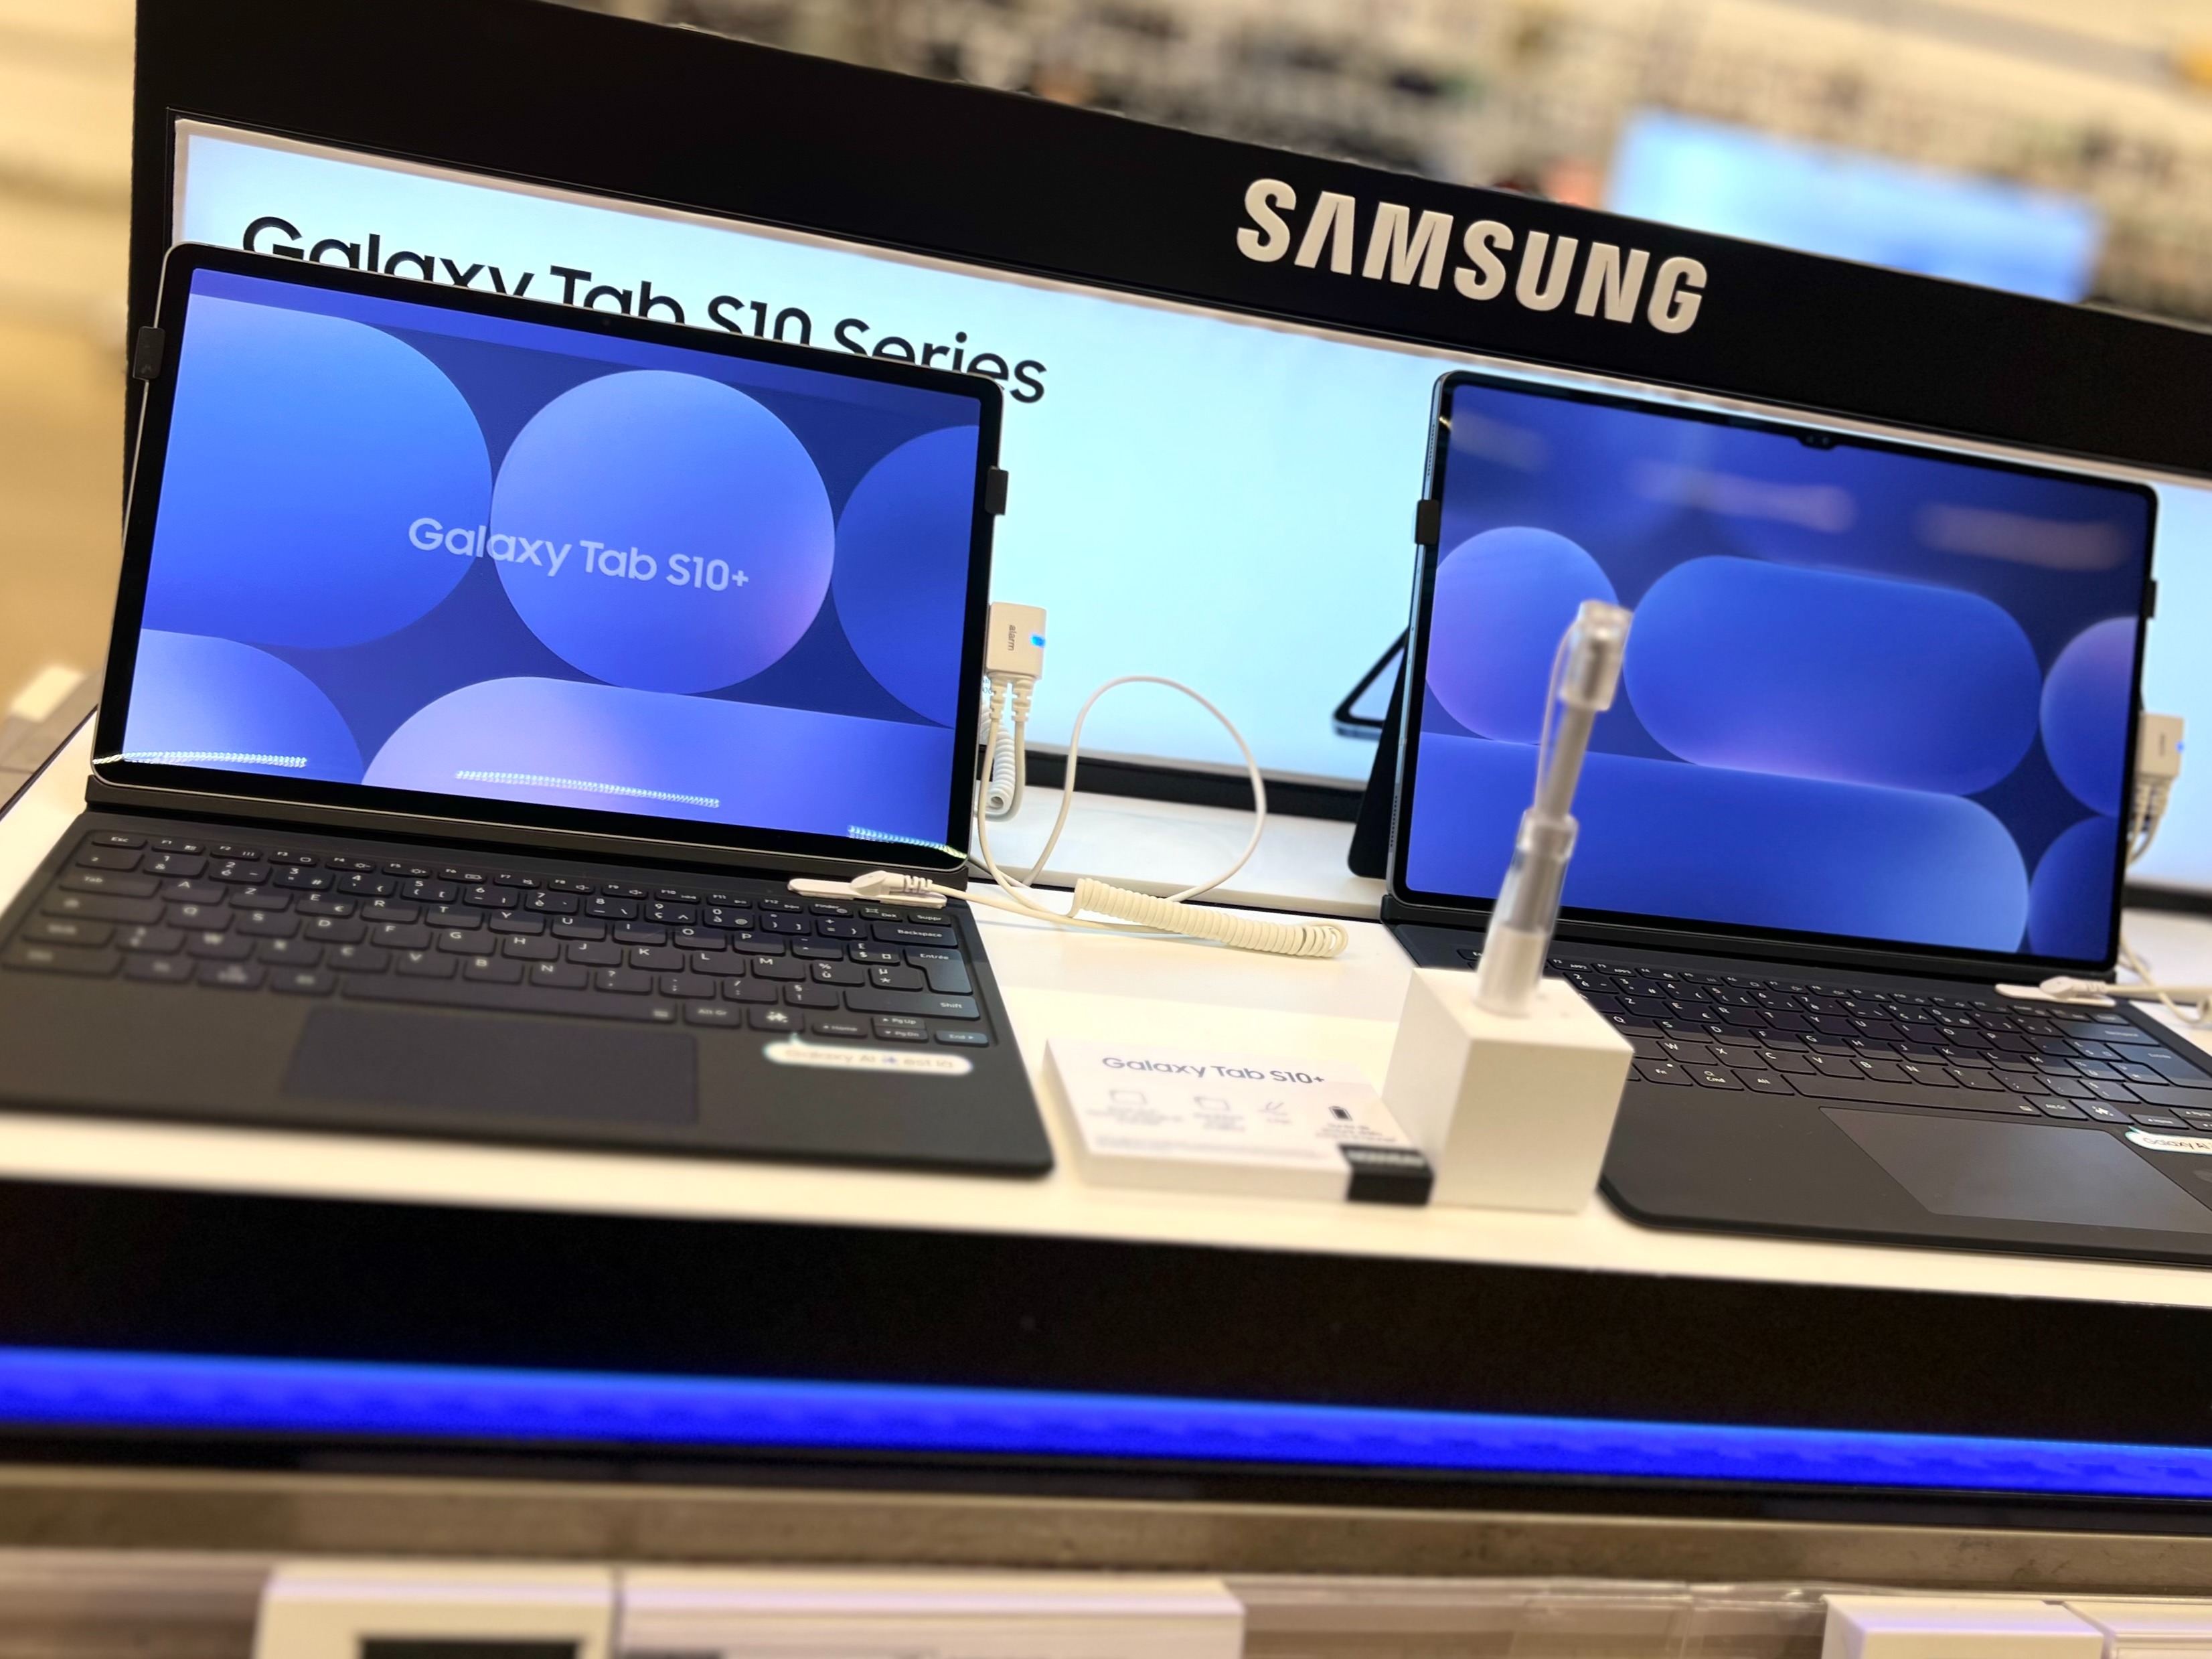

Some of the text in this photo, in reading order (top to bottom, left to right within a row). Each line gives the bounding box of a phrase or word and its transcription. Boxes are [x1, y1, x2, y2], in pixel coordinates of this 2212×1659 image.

[1237, 178, 1708, 333] SAMSUNG
[550, 264, 685, 324] Tab
[707, 295, 811, 347] S10
[834, 318, 1047, 404] Series
[408, 518, 749, 591] Galaxy Tab S10+
[1008, 625, 1017, 651] alarm
[898, 929, 942, 937] Backspace
[1102, 1057, 1325, 1084] Galaxy Tab S10+
